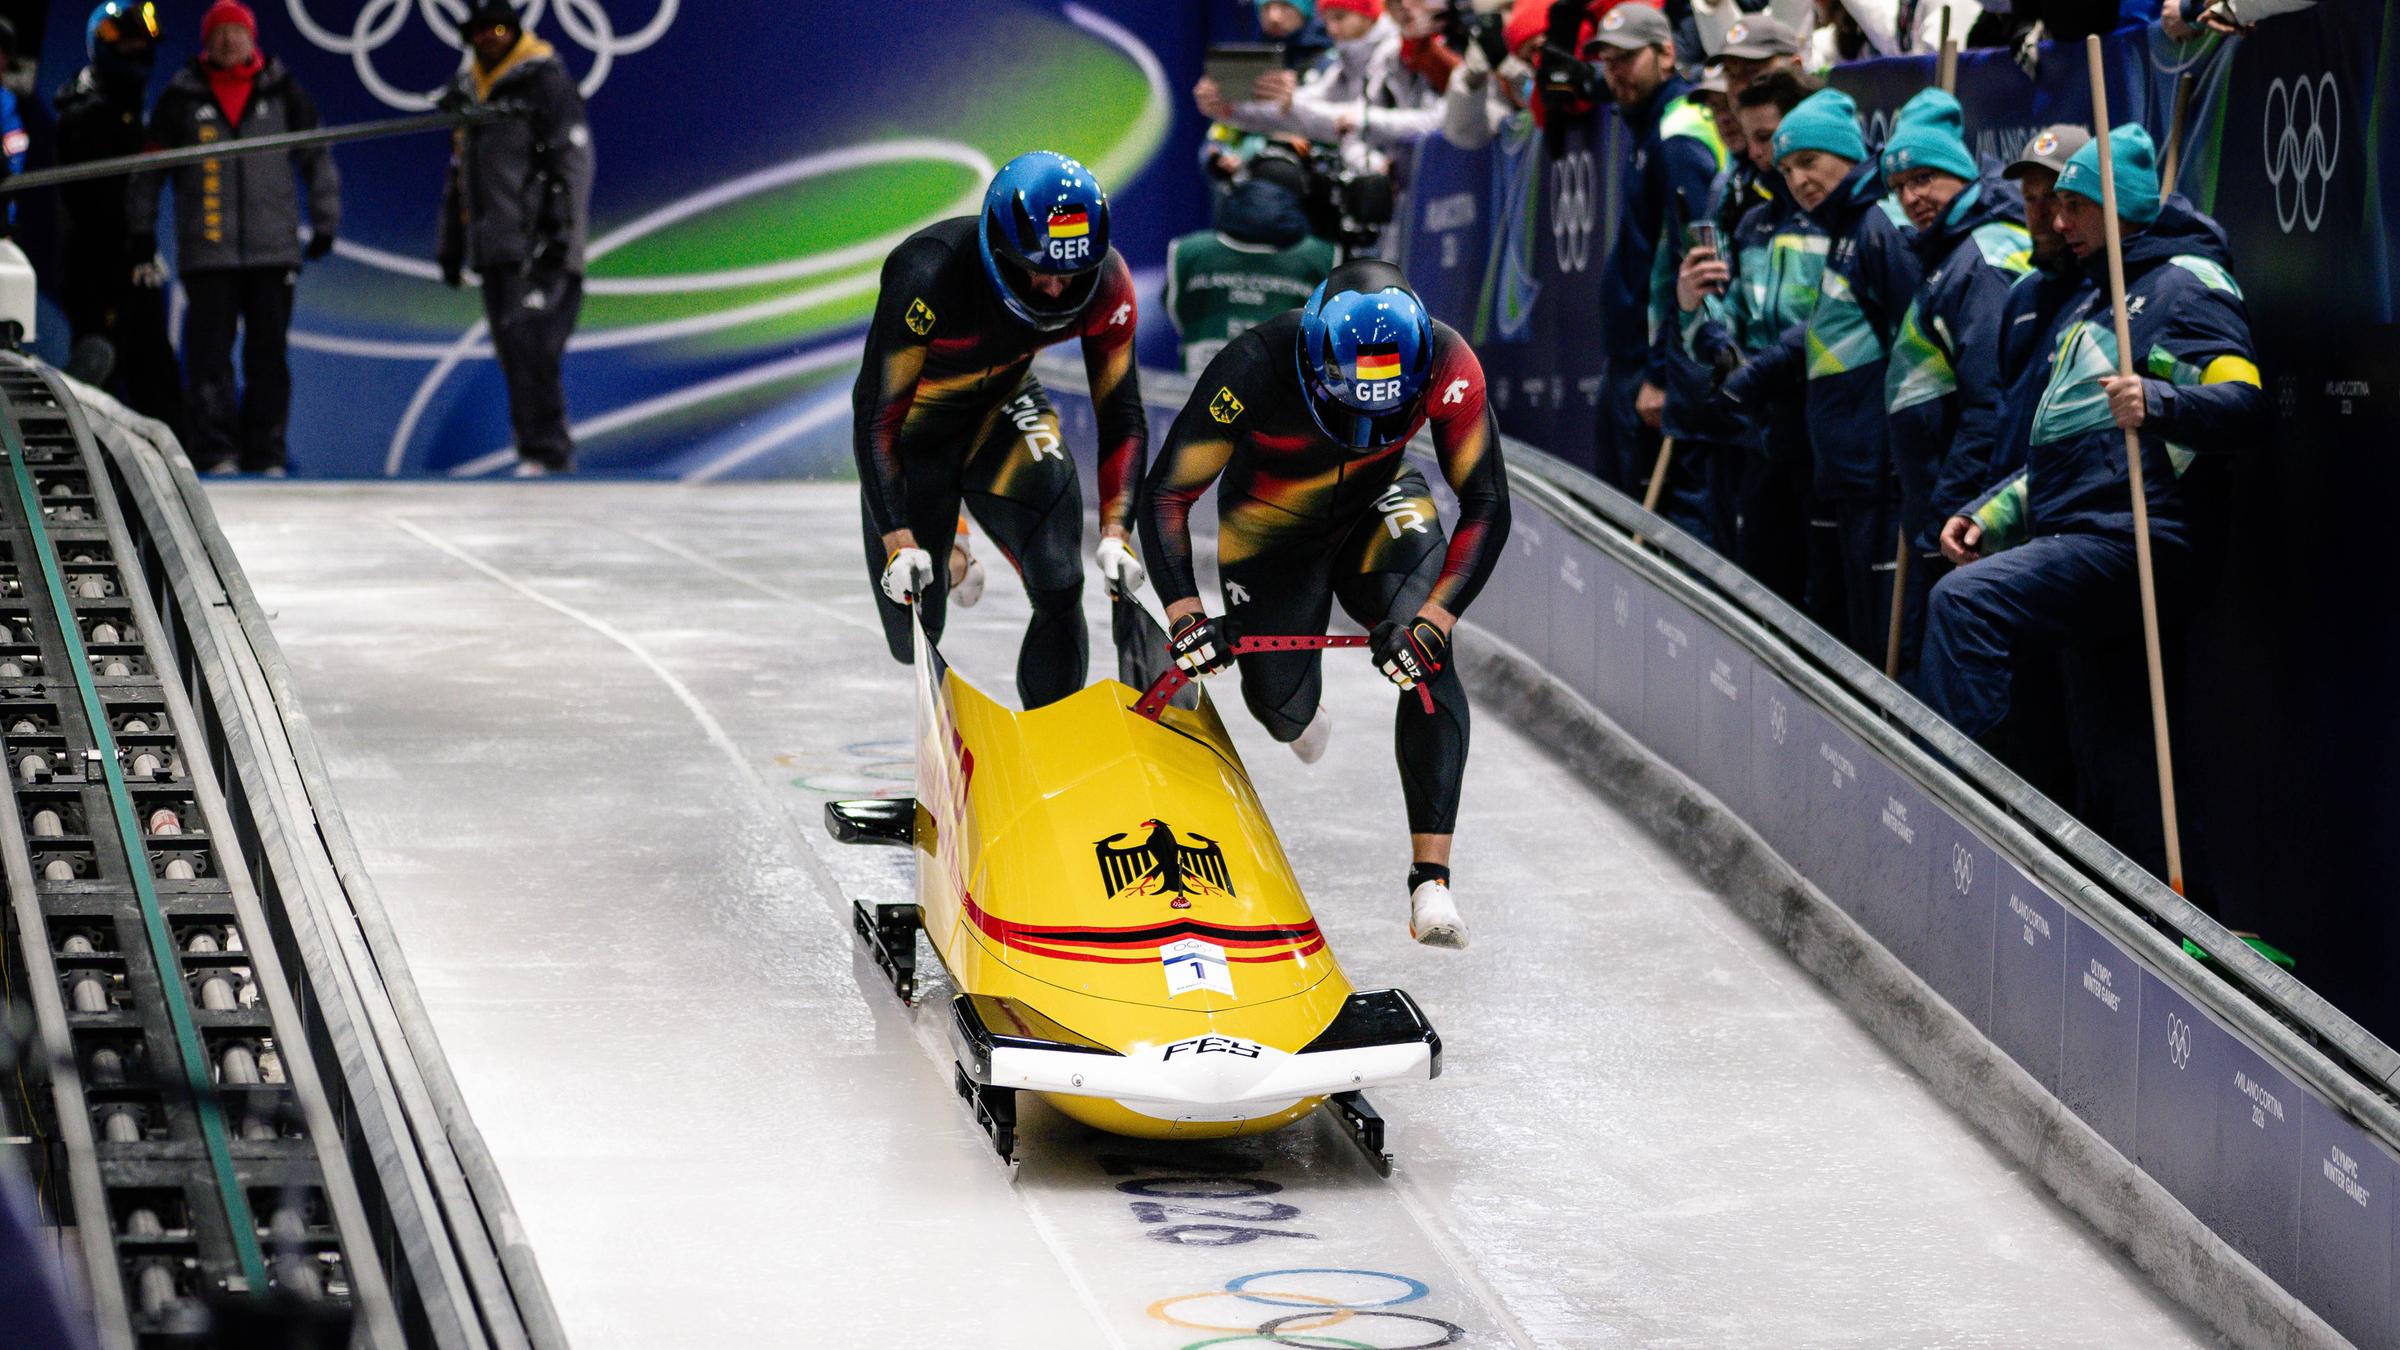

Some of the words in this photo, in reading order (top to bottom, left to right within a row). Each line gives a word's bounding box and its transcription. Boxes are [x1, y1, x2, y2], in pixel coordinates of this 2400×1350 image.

[1049, 237, 1090, 260] GER
[1356, 381, 1401, 402] GER
[1176, 626, 1207, 652] SEIZ
[1398, 649, 1421, 678] SEIZ
[2009, 893, 2028, 921] MILANO
[2029, 908, 2050, 940] CORTINA
[1190, 962, 1206, 979] 1
[2091, 958, 2112, 987] OLYMPIC
[2083, 971, 2101, 999] WINTER
[1163, 1037, 1262, 1062] FES
[2234, 1070, 2259, 1101] MILANO
[2259, 1088, 2285, 1123] CORTINA
[2252, 1105, 2265, 1128] 2026
[2323, 1158, 2345, 1191] WINTER
[2331, 1145, 2358, 1179] OLYMPIC
